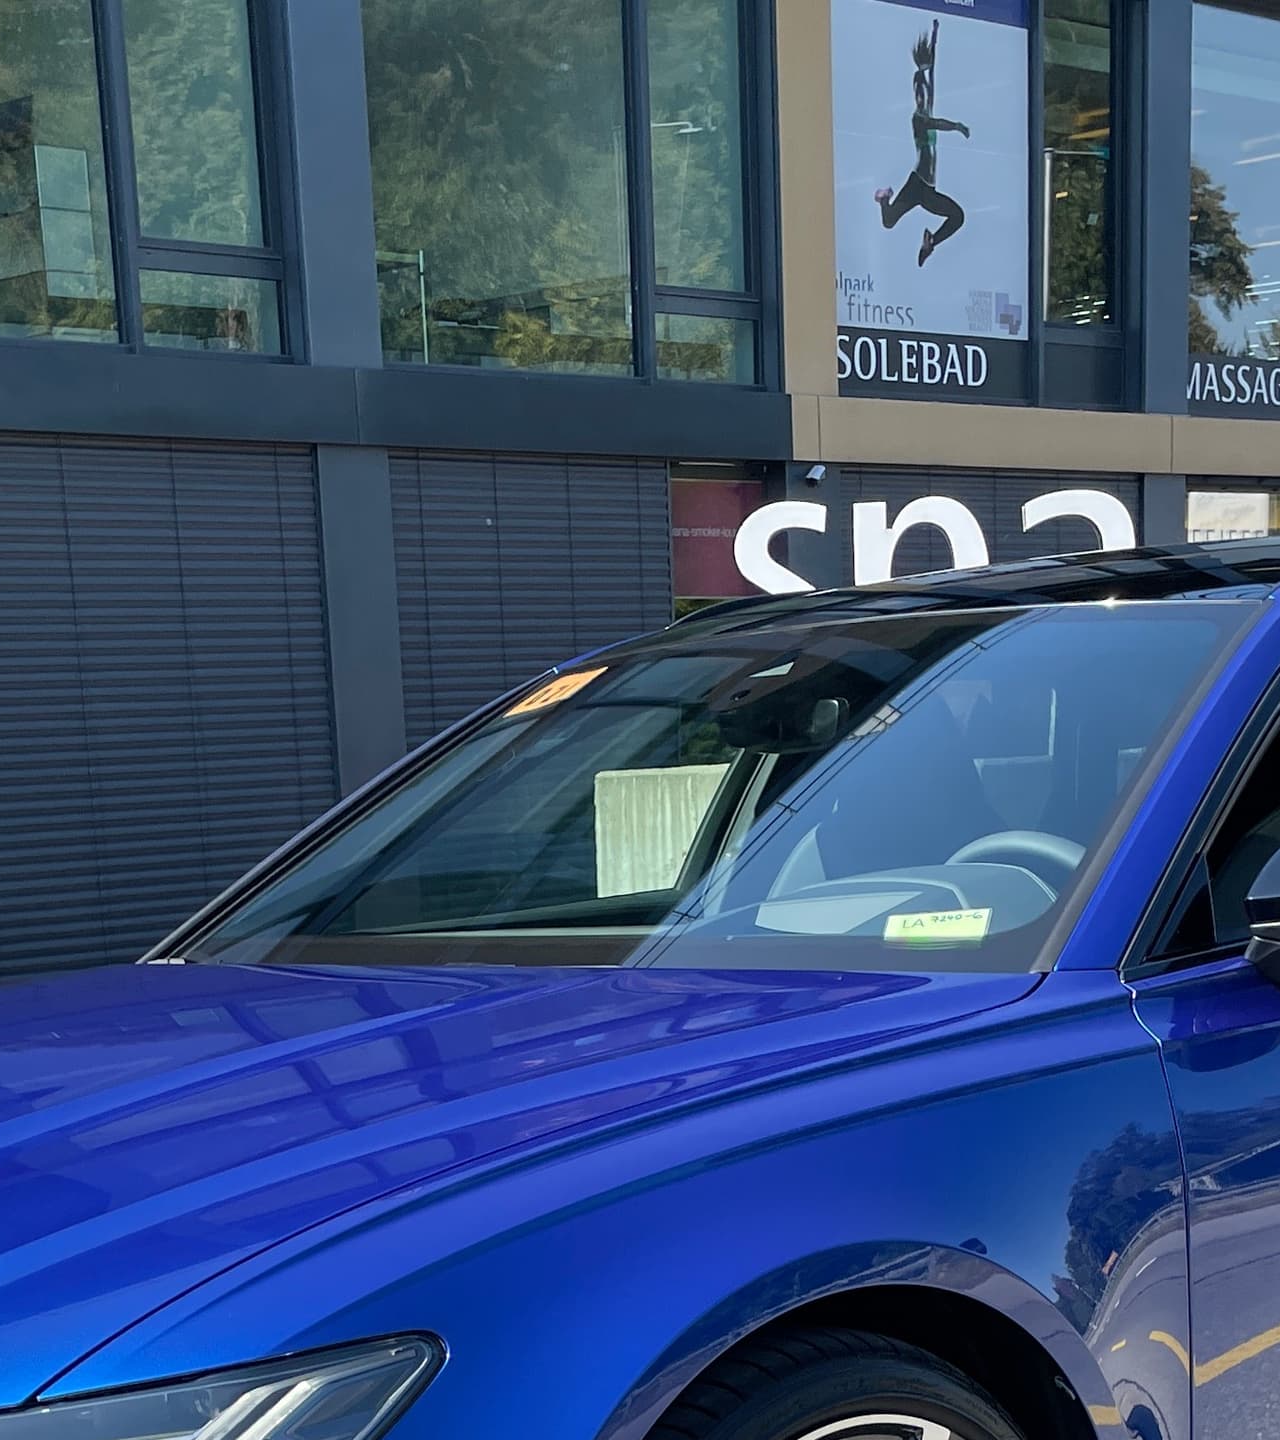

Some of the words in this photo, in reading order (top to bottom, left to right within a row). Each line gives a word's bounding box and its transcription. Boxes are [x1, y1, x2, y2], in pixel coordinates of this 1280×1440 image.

[847, 294, 915, 327] fitness
[836, 335, 988, 387] SOLEBAD
[902, 918, 925, 929] LA
